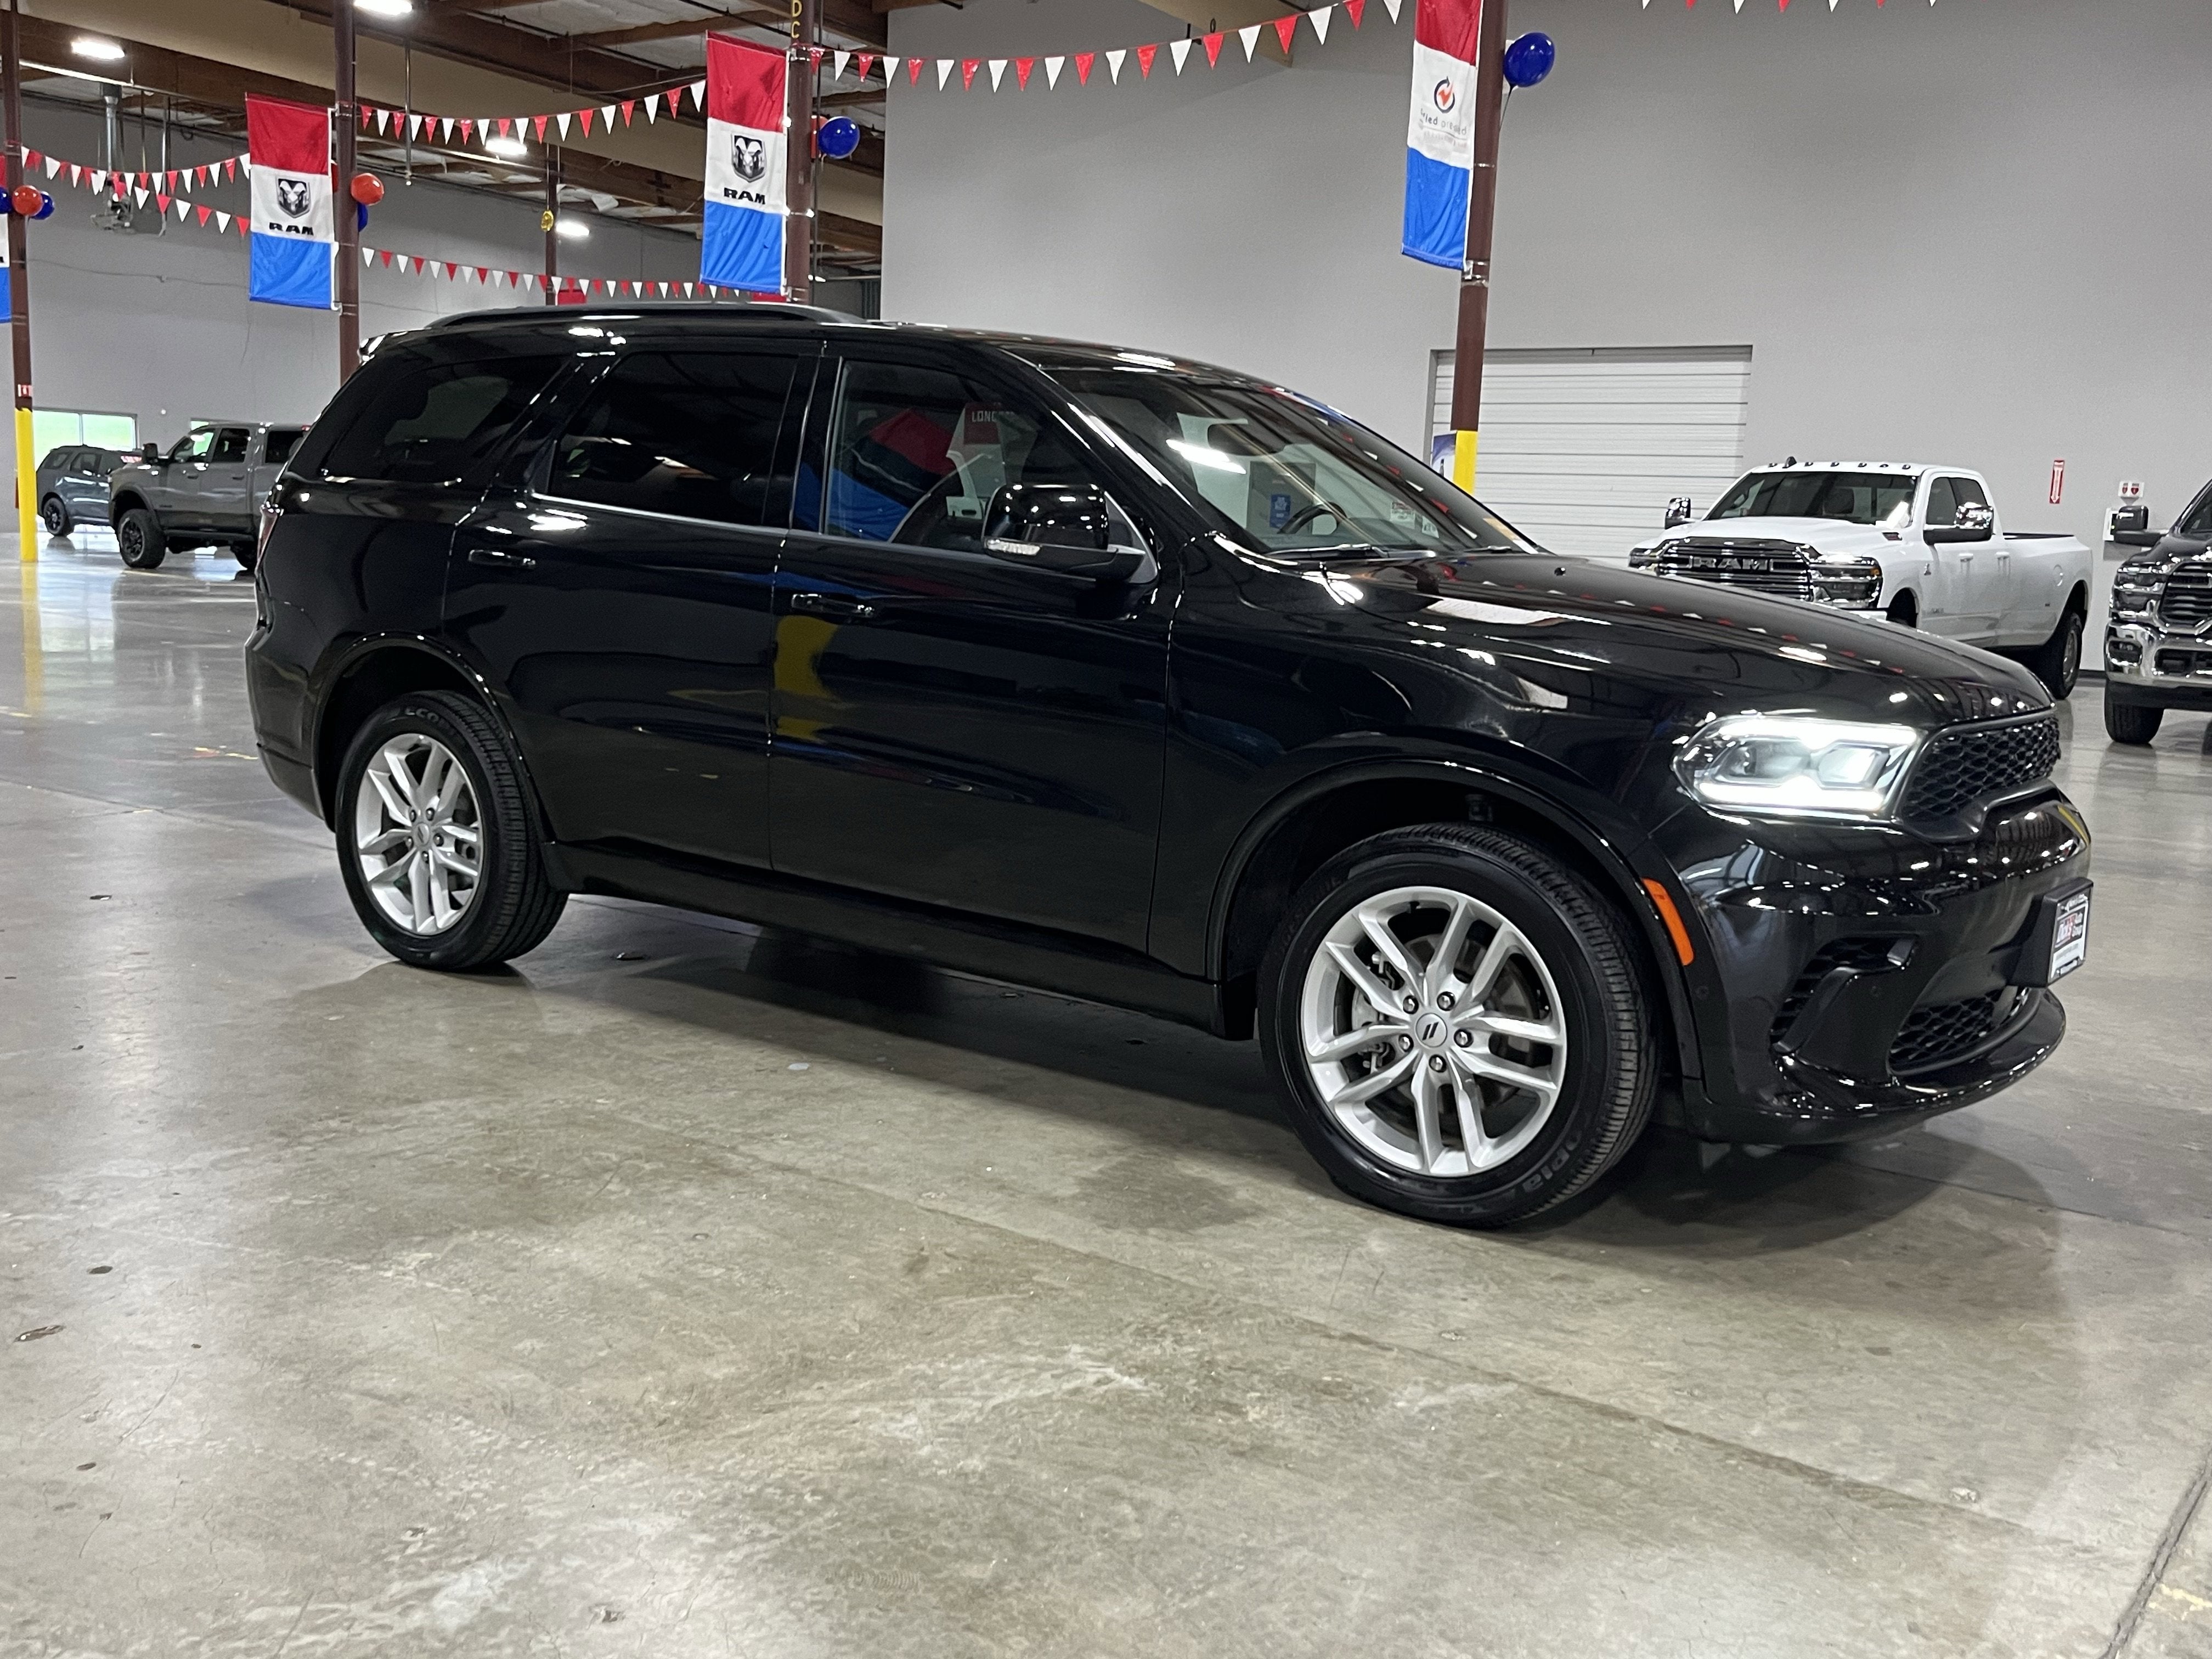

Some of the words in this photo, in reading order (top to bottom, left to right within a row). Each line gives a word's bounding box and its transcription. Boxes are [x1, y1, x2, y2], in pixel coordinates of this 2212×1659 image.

[724, 187, 766, 205] RAM
[269, 222, 314, 235] RAM
[1693, 556, 1768, 571] RAM
